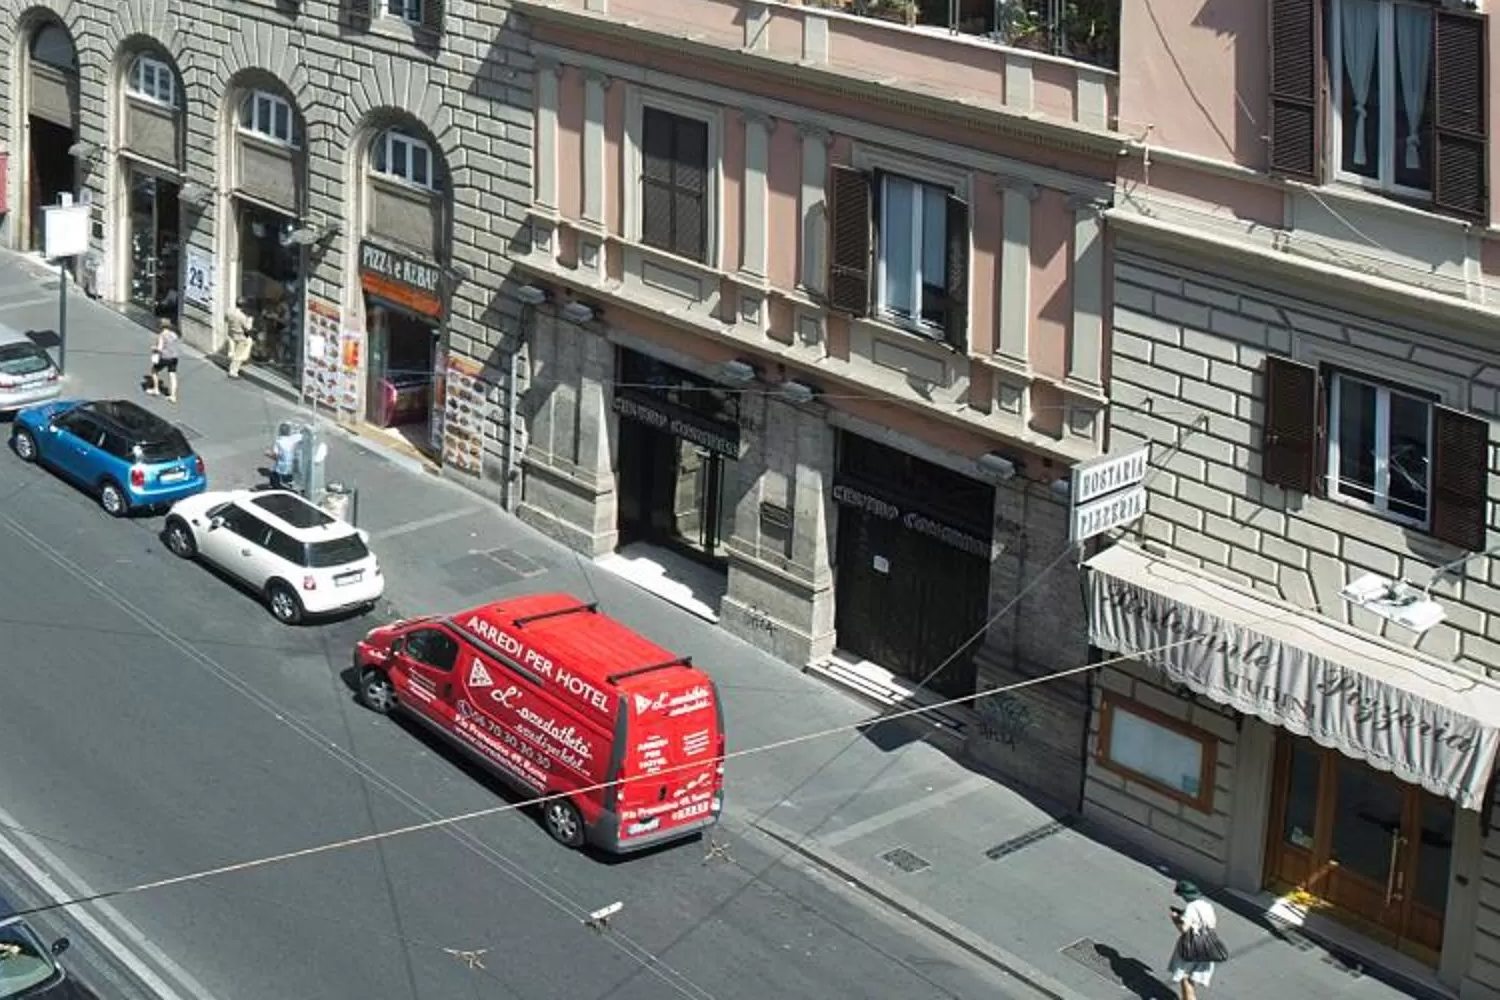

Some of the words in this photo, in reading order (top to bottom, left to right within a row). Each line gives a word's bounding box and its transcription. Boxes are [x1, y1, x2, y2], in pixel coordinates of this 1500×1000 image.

[363, 246, 393, 275] PIZZA
[1080, 494, 1141, 538] PIZZERIA
[467, 616, 523, 658] ARREDI
[525, 649, 553, 677] PER
[555, 667, 609, 713] HOTEL
[1317, 666, 1476, 755] Pizzeria
